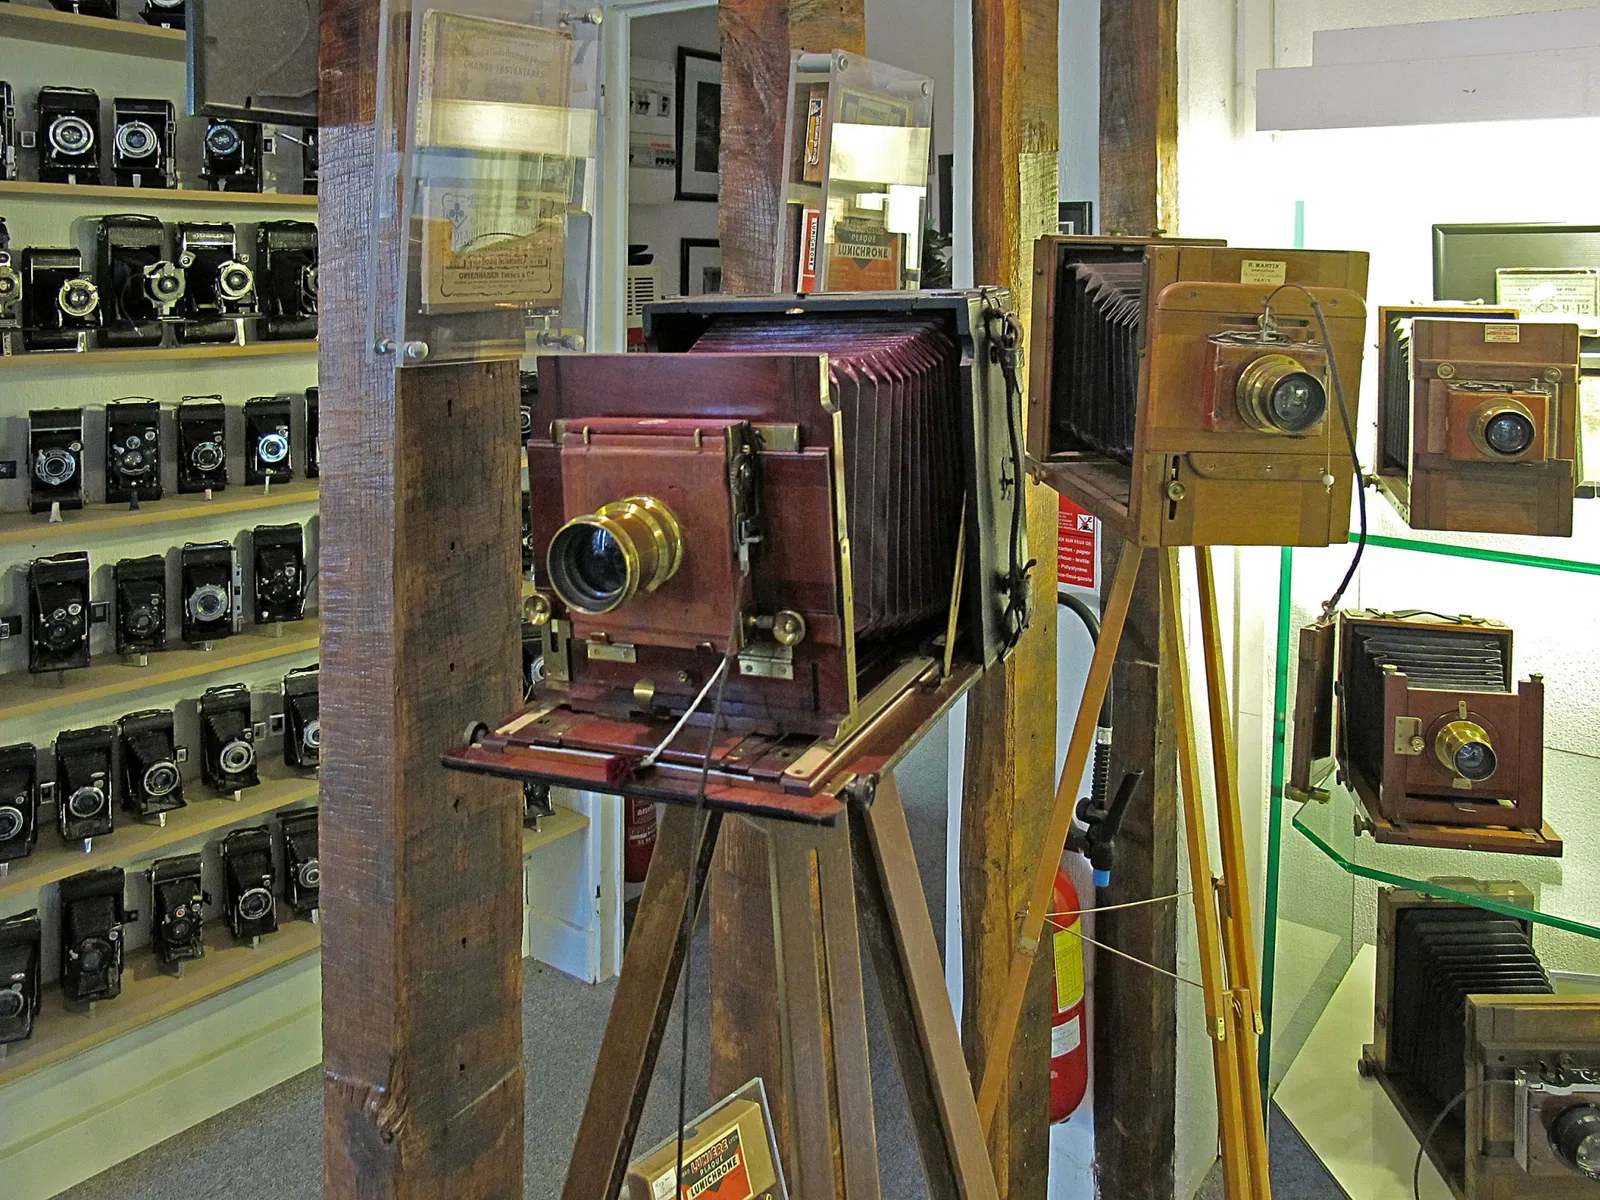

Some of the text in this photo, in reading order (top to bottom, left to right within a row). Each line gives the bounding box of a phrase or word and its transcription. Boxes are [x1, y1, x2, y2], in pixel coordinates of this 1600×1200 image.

[838, 244, 888, 259] LUMICHROME
[699, 1155, 724, 1176] PLAQUE
[690, 1156, 738, 1197] LUMICHROME
